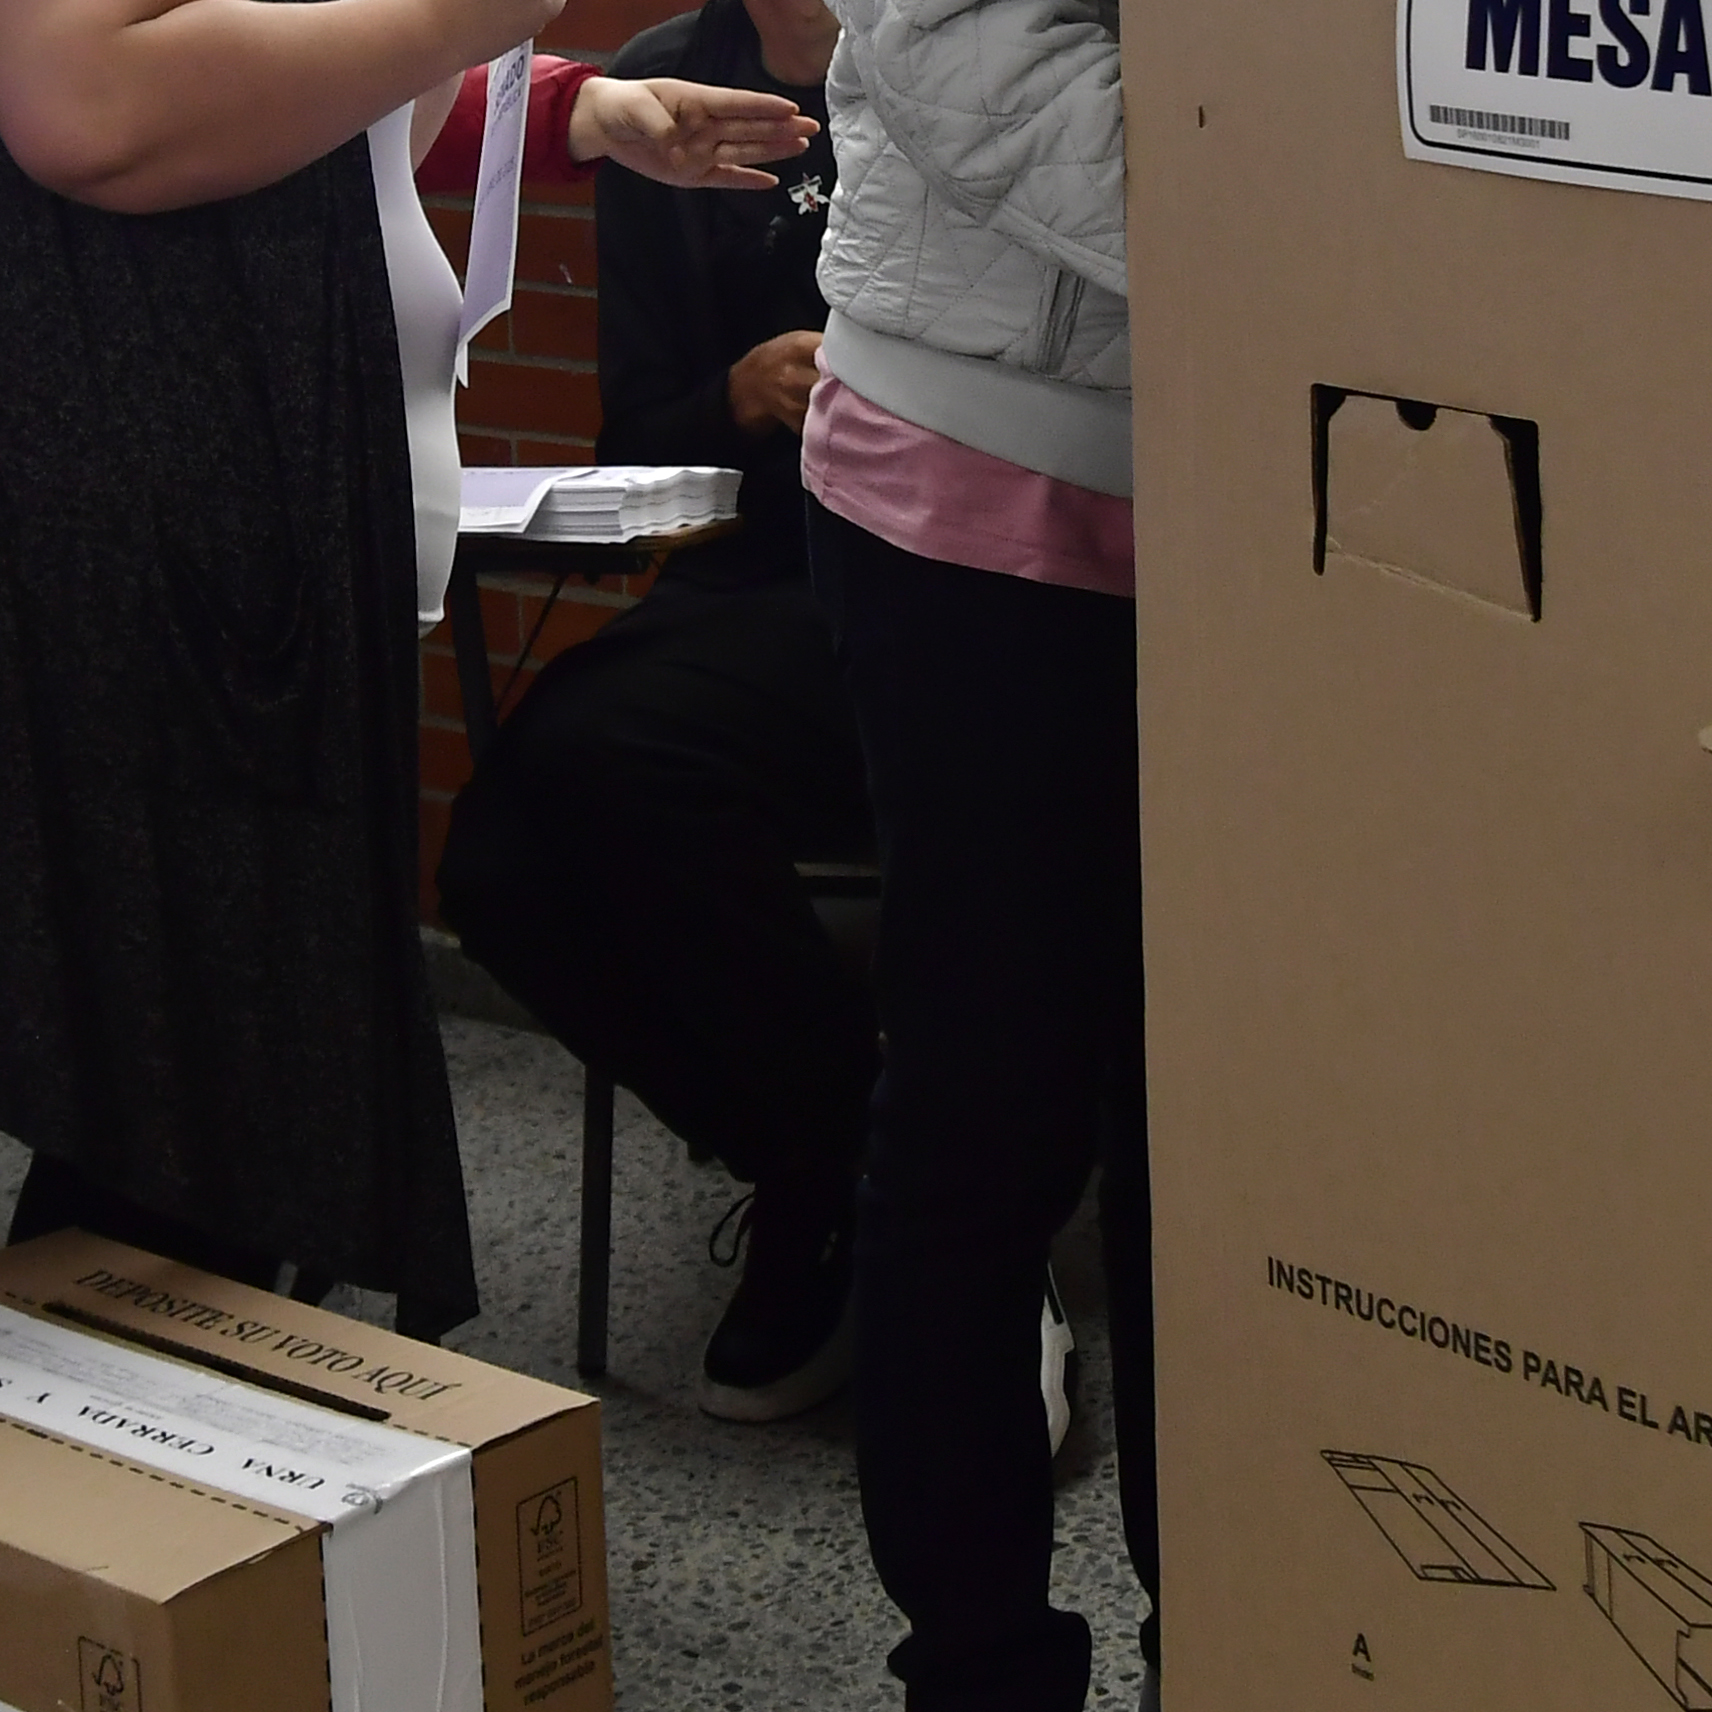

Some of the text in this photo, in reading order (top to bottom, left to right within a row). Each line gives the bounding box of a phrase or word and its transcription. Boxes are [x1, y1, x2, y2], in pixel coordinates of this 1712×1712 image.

[74, 1267, 462, 1401] DEPOSITE SU VOTO AQUÍ
[1267, 1256, 1513, 1374] INSTRUCCIONES
[1522, 1349, 1610, 1413] PARA
[1616, 1384, 1660, 1430] EL
[26, 1392, 52, 1405] Y
[77, 1404, 216, 1457] CERRADA
[241, 1457, 326, 1491] URNA
[1352, 1632, 1372, 1663] A
